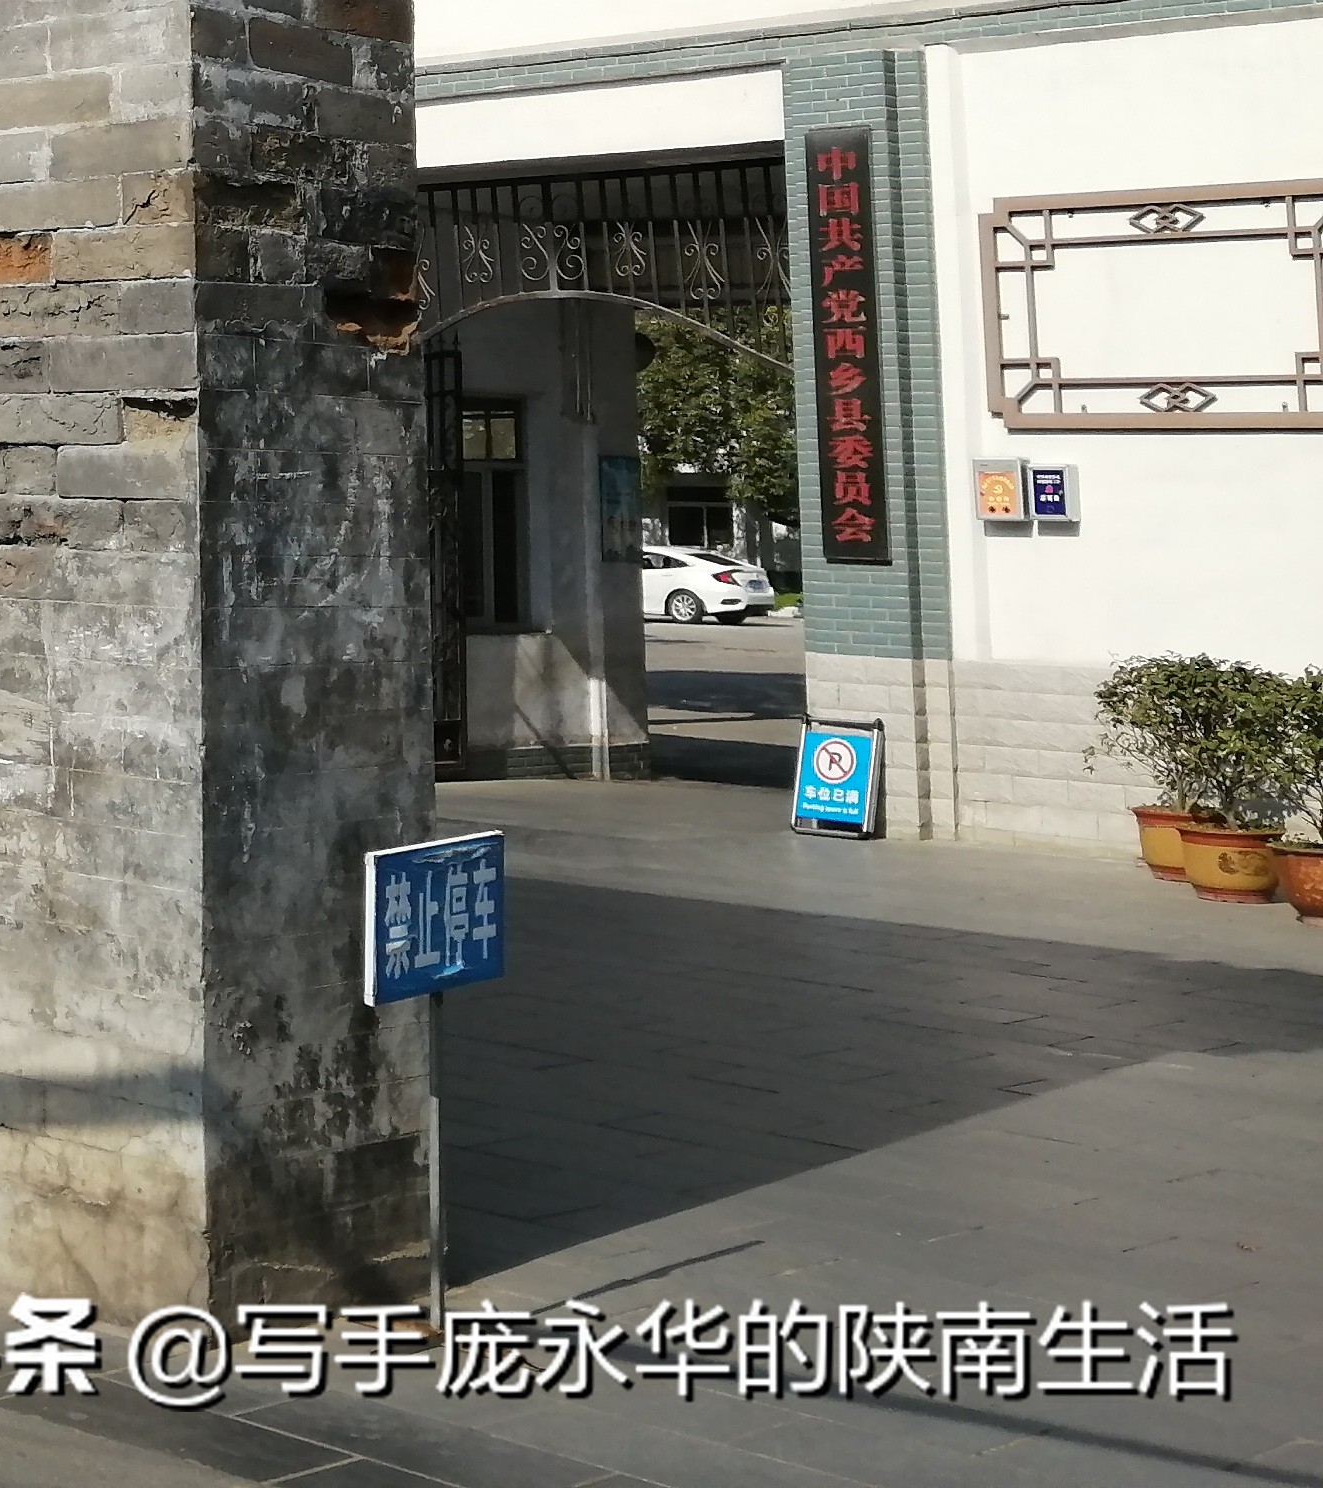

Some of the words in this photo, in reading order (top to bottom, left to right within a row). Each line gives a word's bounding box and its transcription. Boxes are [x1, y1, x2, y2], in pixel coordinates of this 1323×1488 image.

[817, 146, 875, 543] 中国共产党西乡县委员会
[384, 858, 497, 980] 禁止停车
